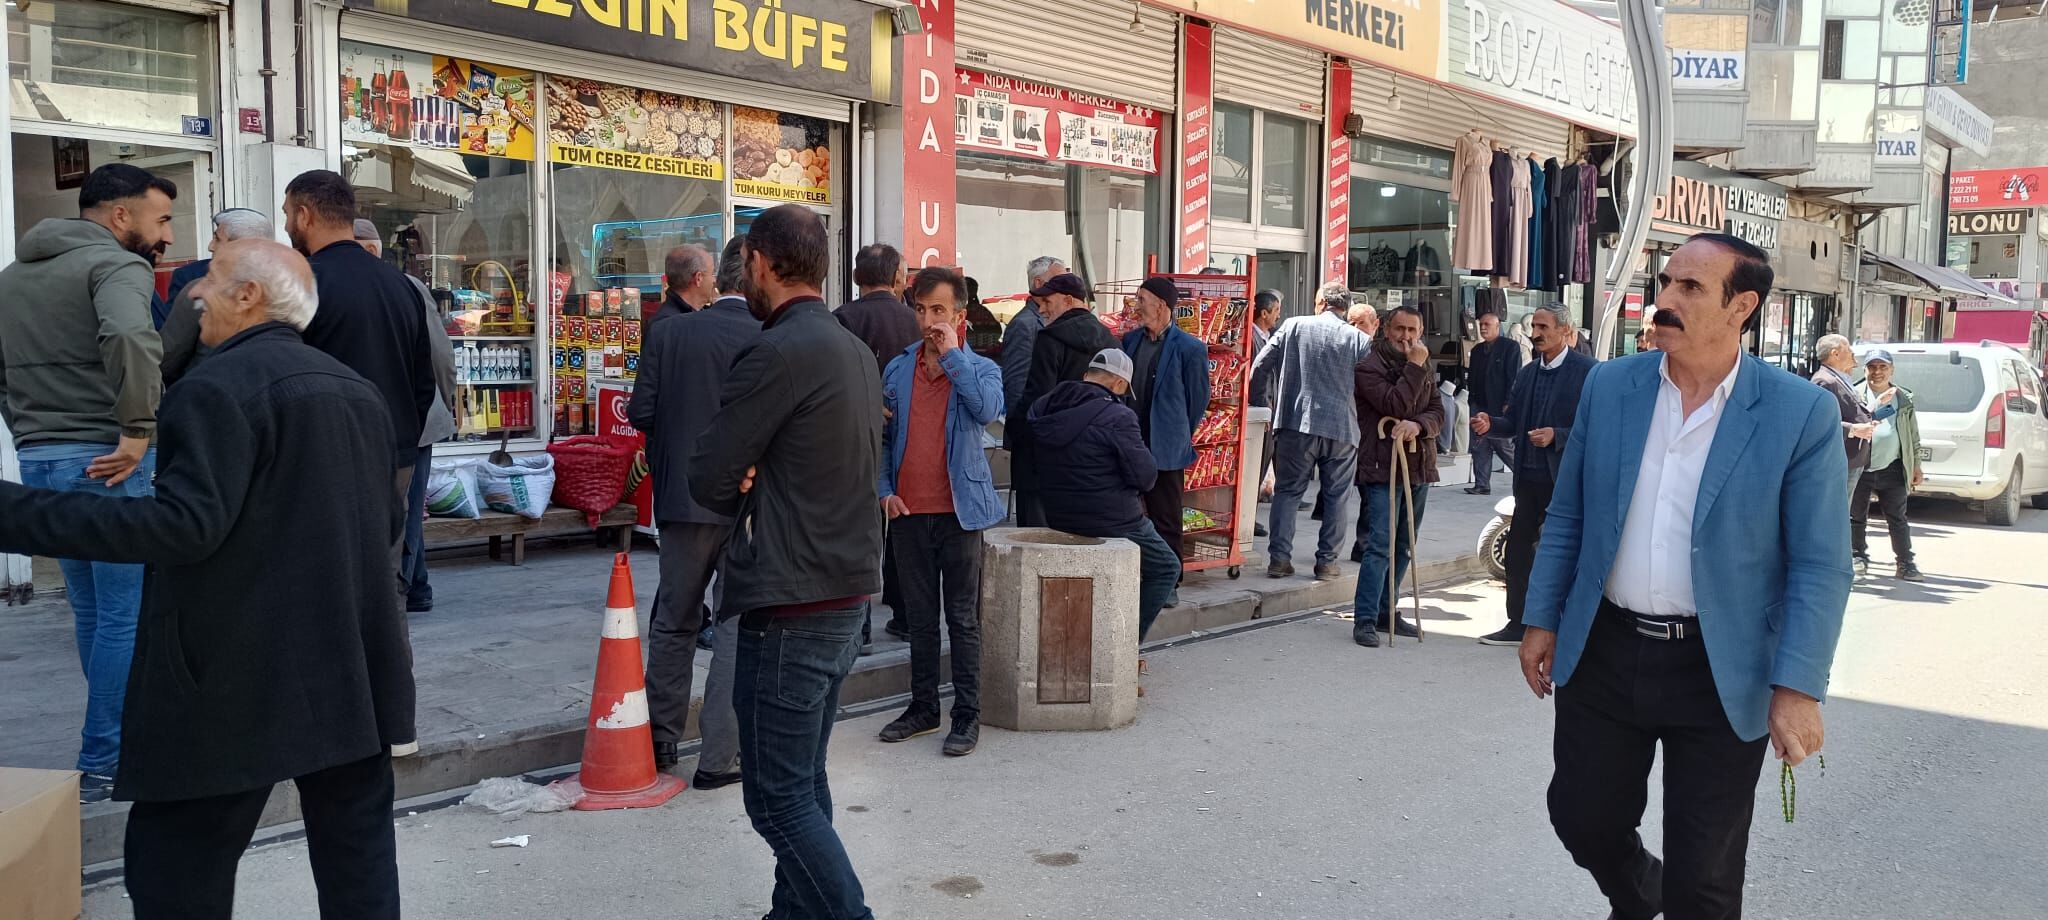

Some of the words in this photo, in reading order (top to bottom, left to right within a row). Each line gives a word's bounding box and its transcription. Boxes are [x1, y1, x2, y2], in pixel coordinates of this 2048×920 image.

[713, 0, 848, 72] BÜFE
[1305, 0, 1404, 50] MERKEZİ
[1465, 0, 1570, 105] ROZA
[1015, 80, 1063, 100] UCUZLUK
[558, 146, 591, 163] TÜM
[735, 183, 754, 194] TÜM
[757, 185, 780, 197] KURU
[783, 189, 827, 202] MEYVELER
[1727, 185, 1741, 211] EV
[1742, 189, 1788, 220] YEMEKLERİ
